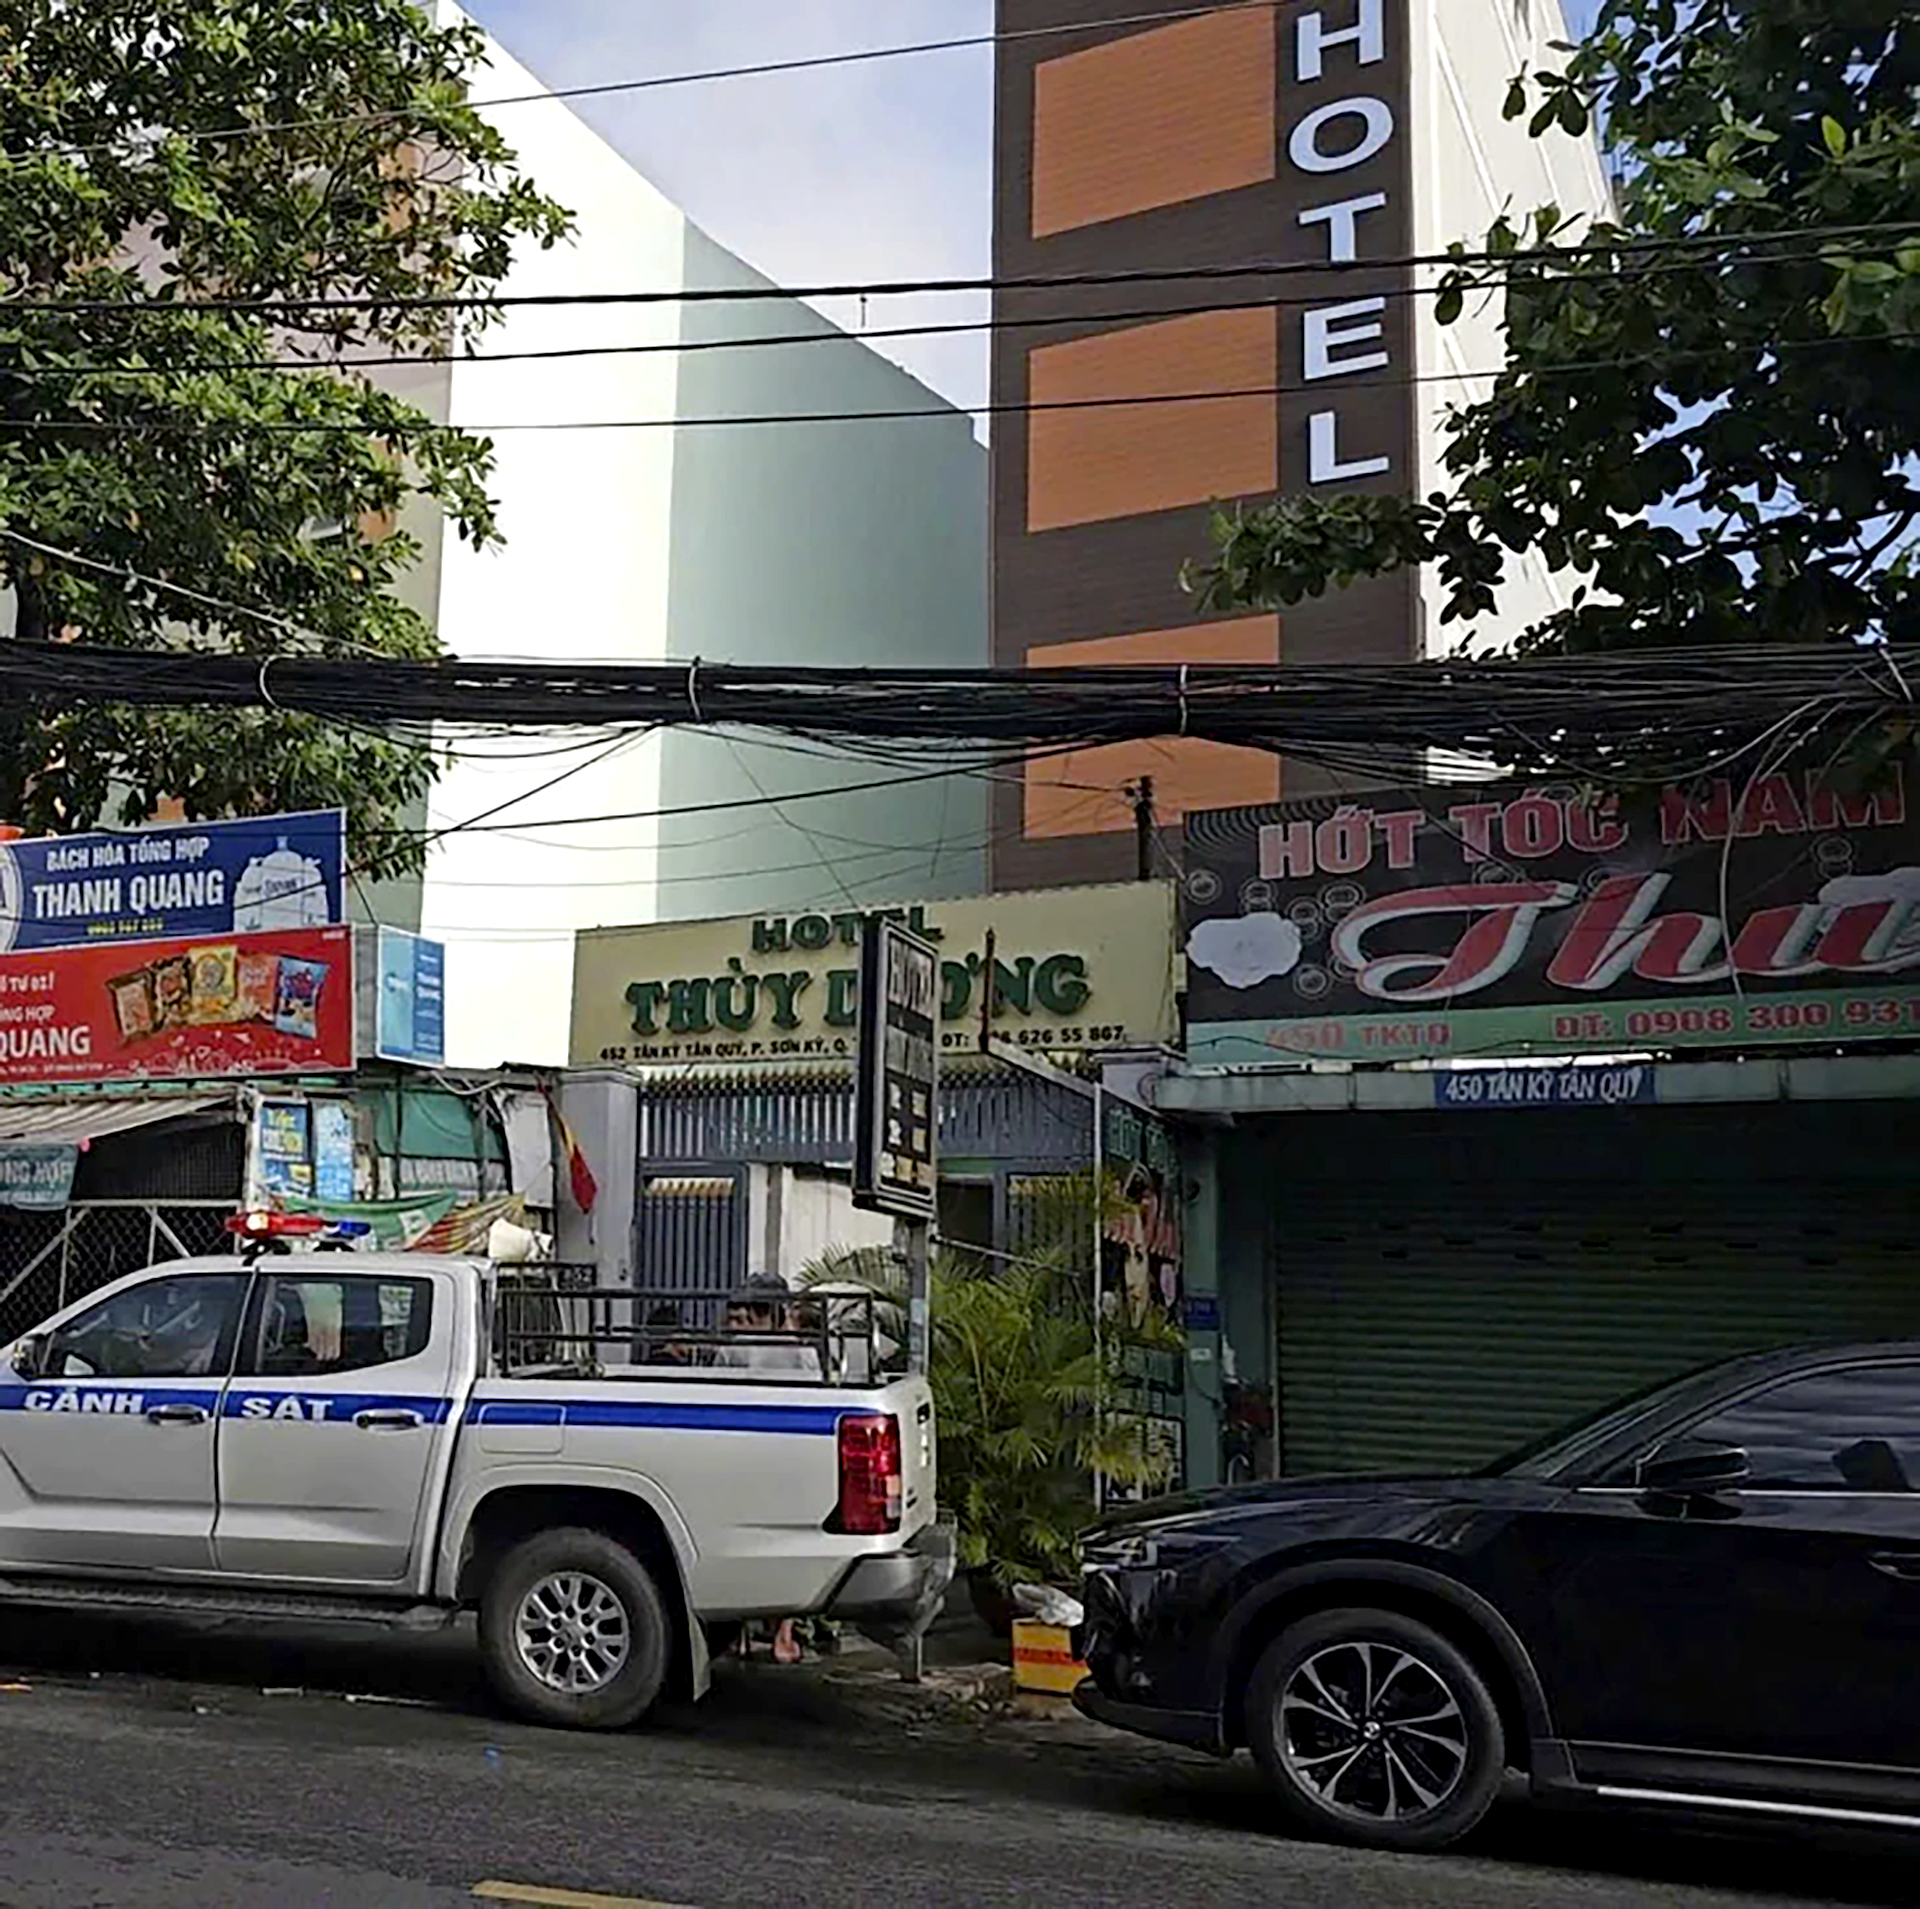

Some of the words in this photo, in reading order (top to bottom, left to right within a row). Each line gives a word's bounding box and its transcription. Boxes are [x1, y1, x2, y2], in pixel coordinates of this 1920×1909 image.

[1288, 0, 1394, 485] HOTEL
[1259, 804, 1426, 880] HỚT
[1449, 787, 1629, 857] TÓC
[1659, 761, 1905, 845] NAM
[175, 836, 210, 864] HỢP
[33, 878, 121, 918] THANH
[129, 869, 225, 915] QUANG
[827, 950, 1093, 1027] DƠNG
[1060, 1027, 1083, 1044] 55
[1626, 1006, 1733, 1037] 0908
[1747, 1003, 1832, 1031] 300
[1446, 1074, 1484, 1101] 450
[1486, 1068, 1524, 1100] TÂN
[1559, 1066, 1595, 1098] TÂN
